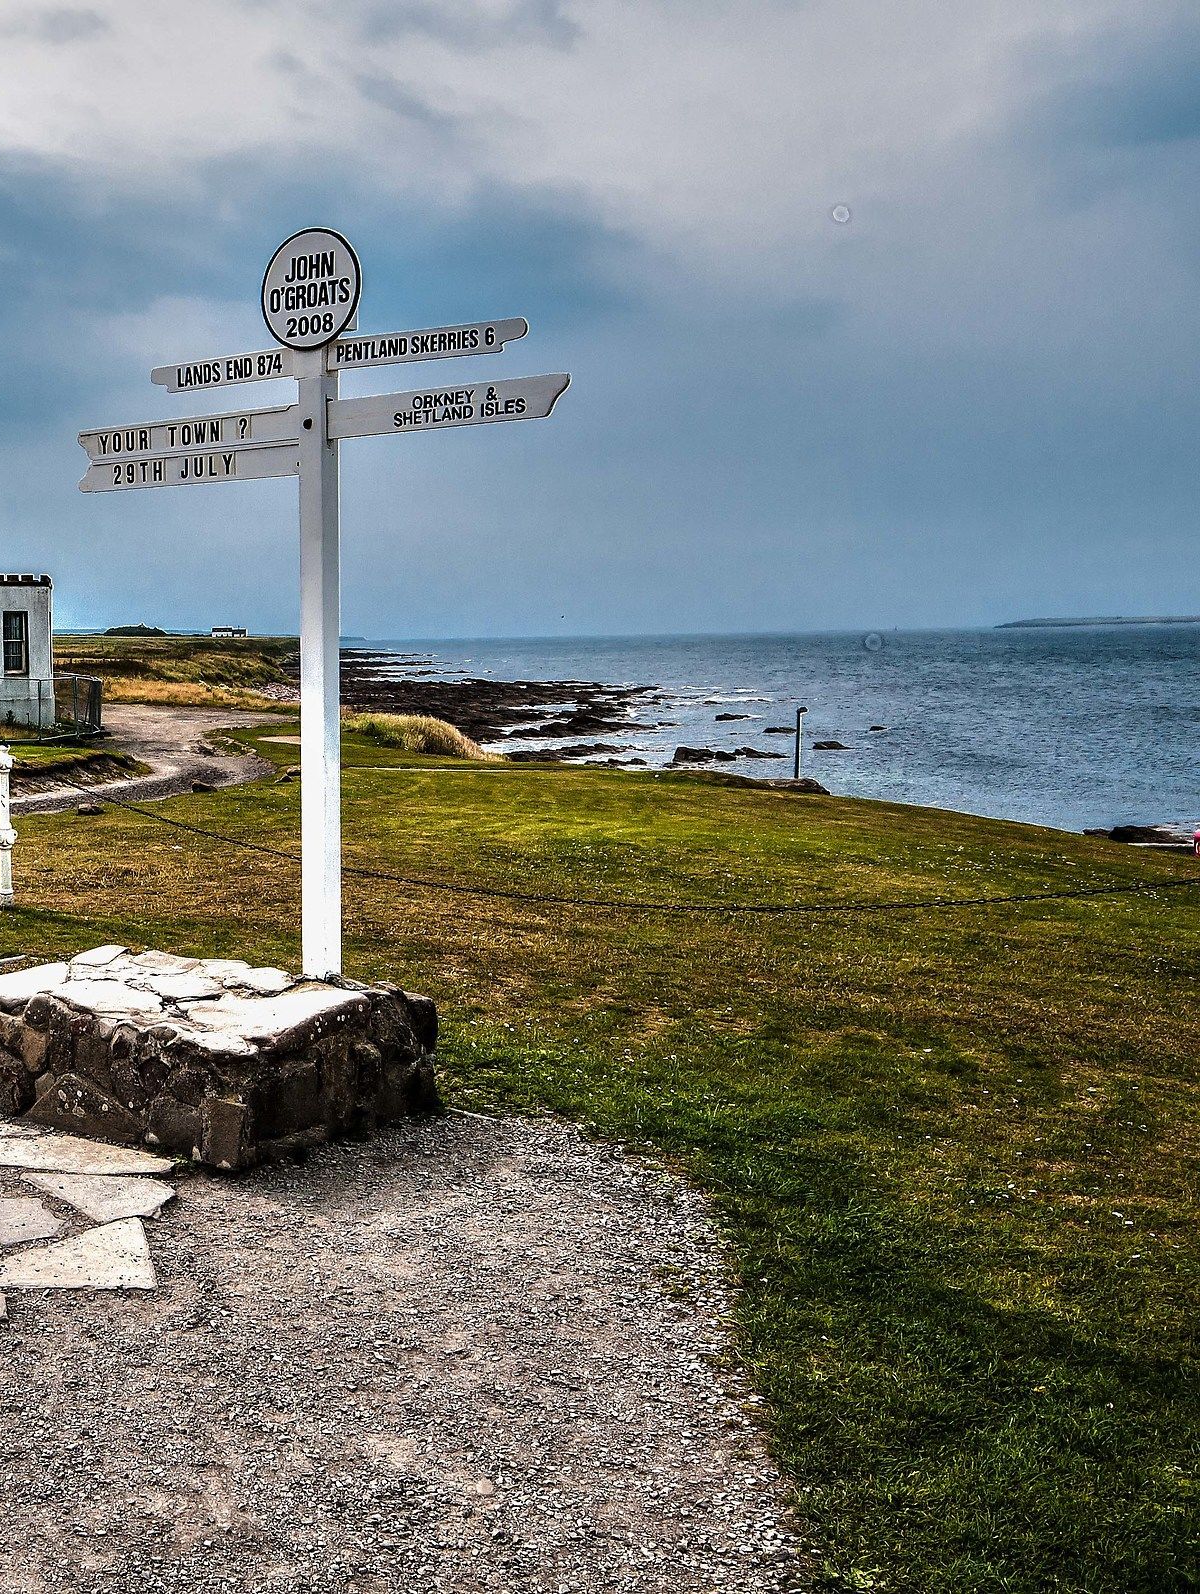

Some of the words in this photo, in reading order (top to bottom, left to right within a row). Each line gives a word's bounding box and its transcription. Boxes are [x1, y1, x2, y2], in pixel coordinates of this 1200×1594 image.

[284, 250, 336, 283] JOHN
[269, 277, 351, 314] O'GROATS
[285, 312, 335, 339] 2008
[336, 337, 408, 363] PENTLAND
[410, 328, 479, 355] SKERRIES
[484, 326, 496, 346] 6
[176, 364, 221, 388] LANDS
[226, 357, 253, 381] END
[257, 353, 283, 376] 874
[393, 405, 475, 428] SHETLAND
[480, 397, 527, 418] ISLES
[411, 389, 476, 410] ORKNEY
[485, 386, 498, 402] &
[98, 429, 149, 455] YOUR
[167, 420, 221, 448] TOWN
[238, 417, 249, 440] ?
[112, 460, 164, 485] 29TH
[180, 453, 234, 479] JULY
